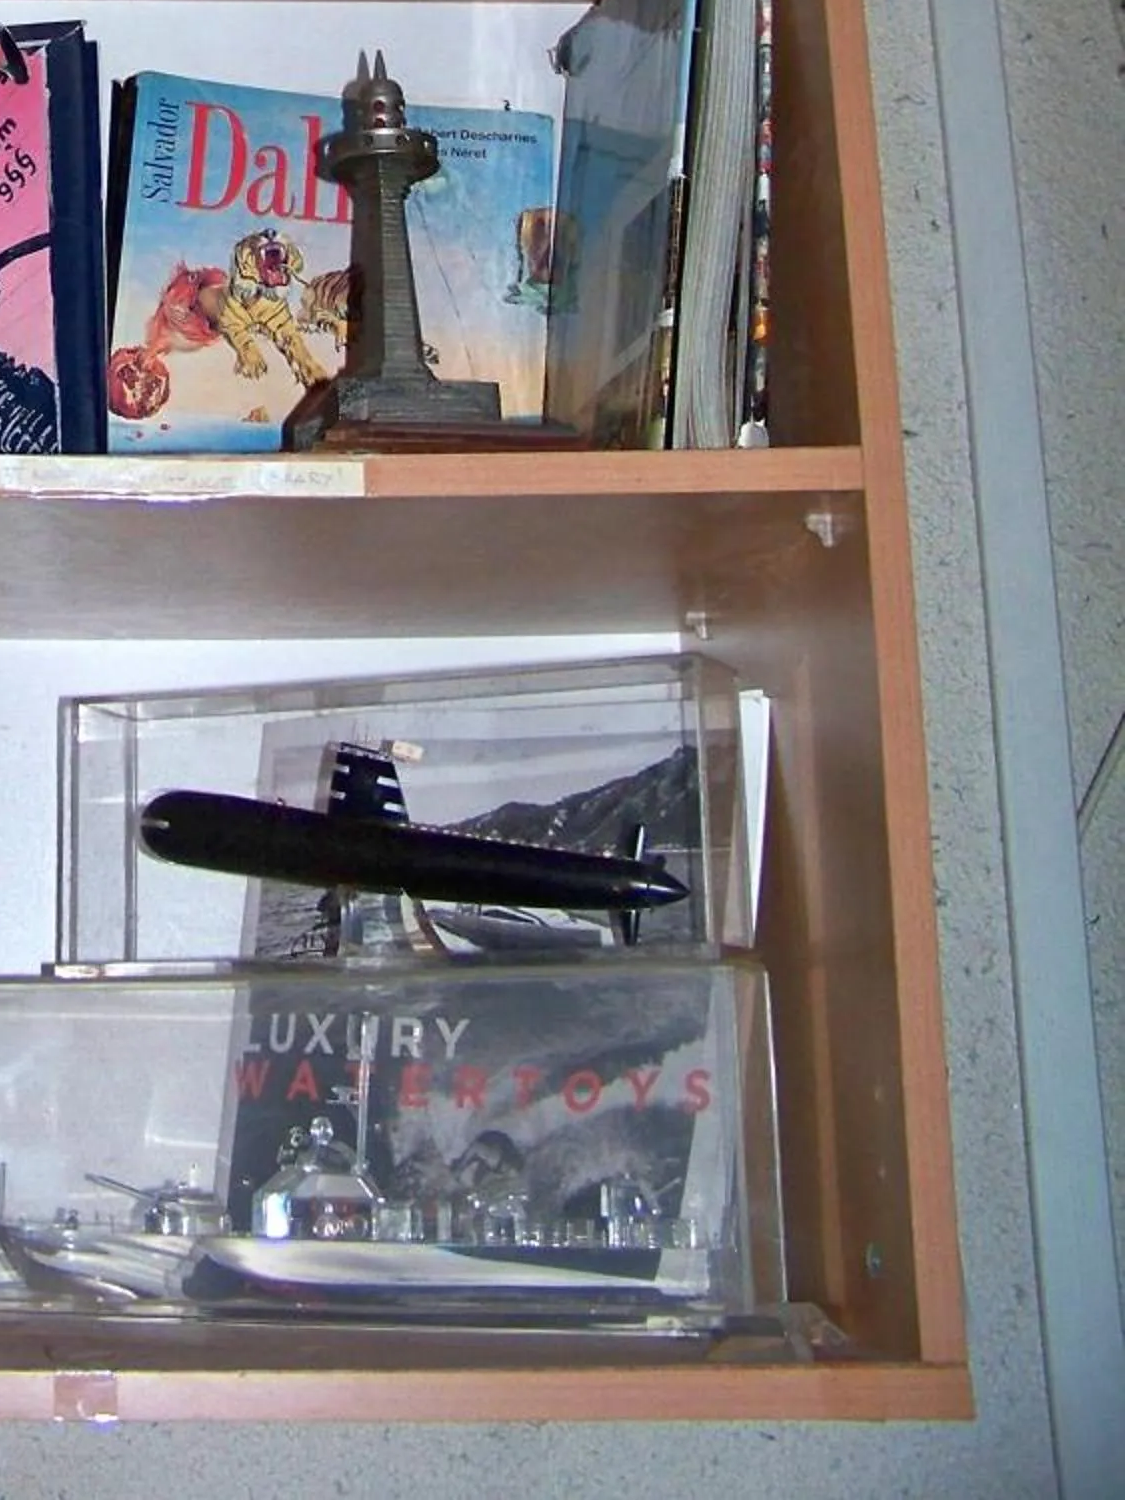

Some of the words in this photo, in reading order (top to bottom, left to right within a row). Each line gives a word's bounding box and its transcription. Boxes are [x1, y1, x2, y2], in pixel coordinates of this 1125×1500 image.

[141, 96, 181, 204] Salvador
[175, 101, 353, 225] Dal
[460, 129, 538, 145] Descharnes
[241, 1011, 472, 1061] LUXURY
